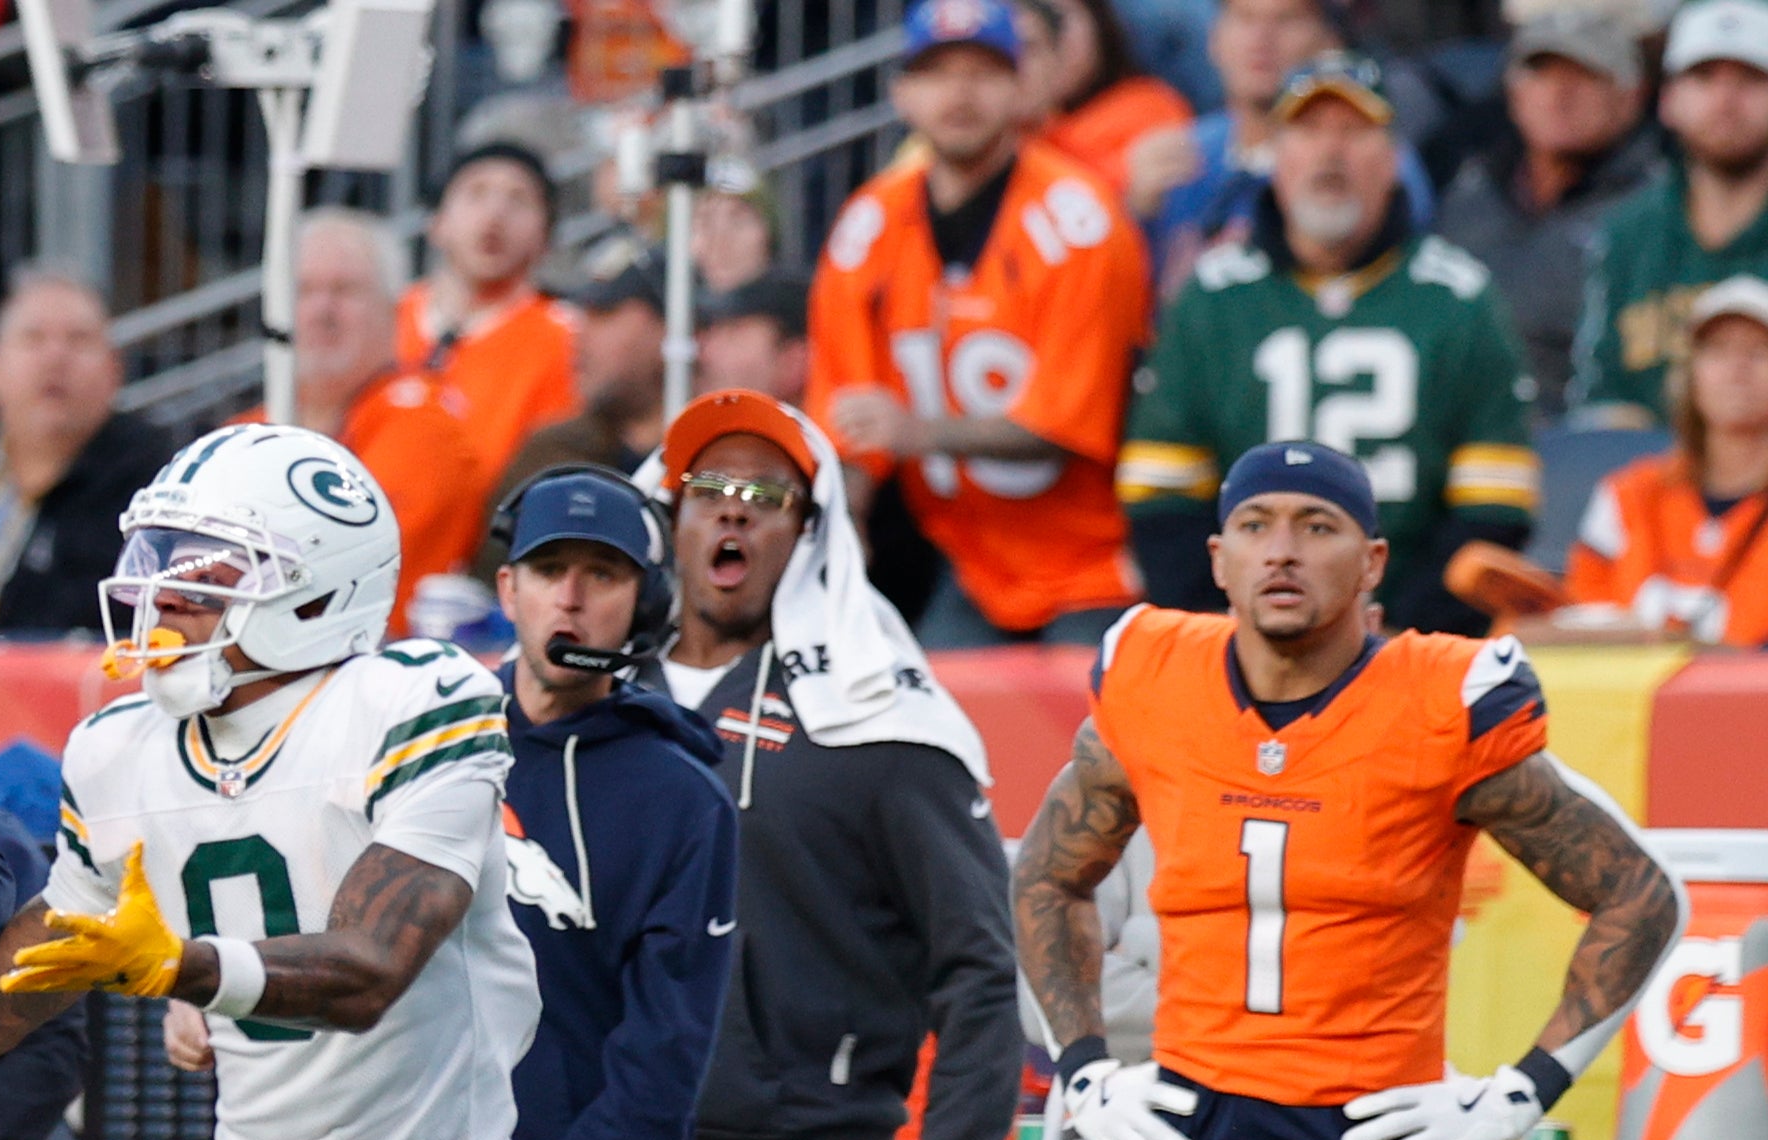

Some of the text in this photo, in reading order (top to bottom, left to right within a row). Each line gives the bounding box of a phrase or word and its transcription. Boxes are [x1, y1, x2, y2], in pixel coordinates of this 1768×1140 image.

[889, 328, 1066, 498] 18
[1253, 326, 1419, 502] 12
[562, 652, 611, 669] SONY
[1219, 793, 1322, 813] BRONCOS
[181, 834, 315, 1042] 0
[1240, 817, 1289, 1015] 1
[1635, 935, 1743, 1077] G
